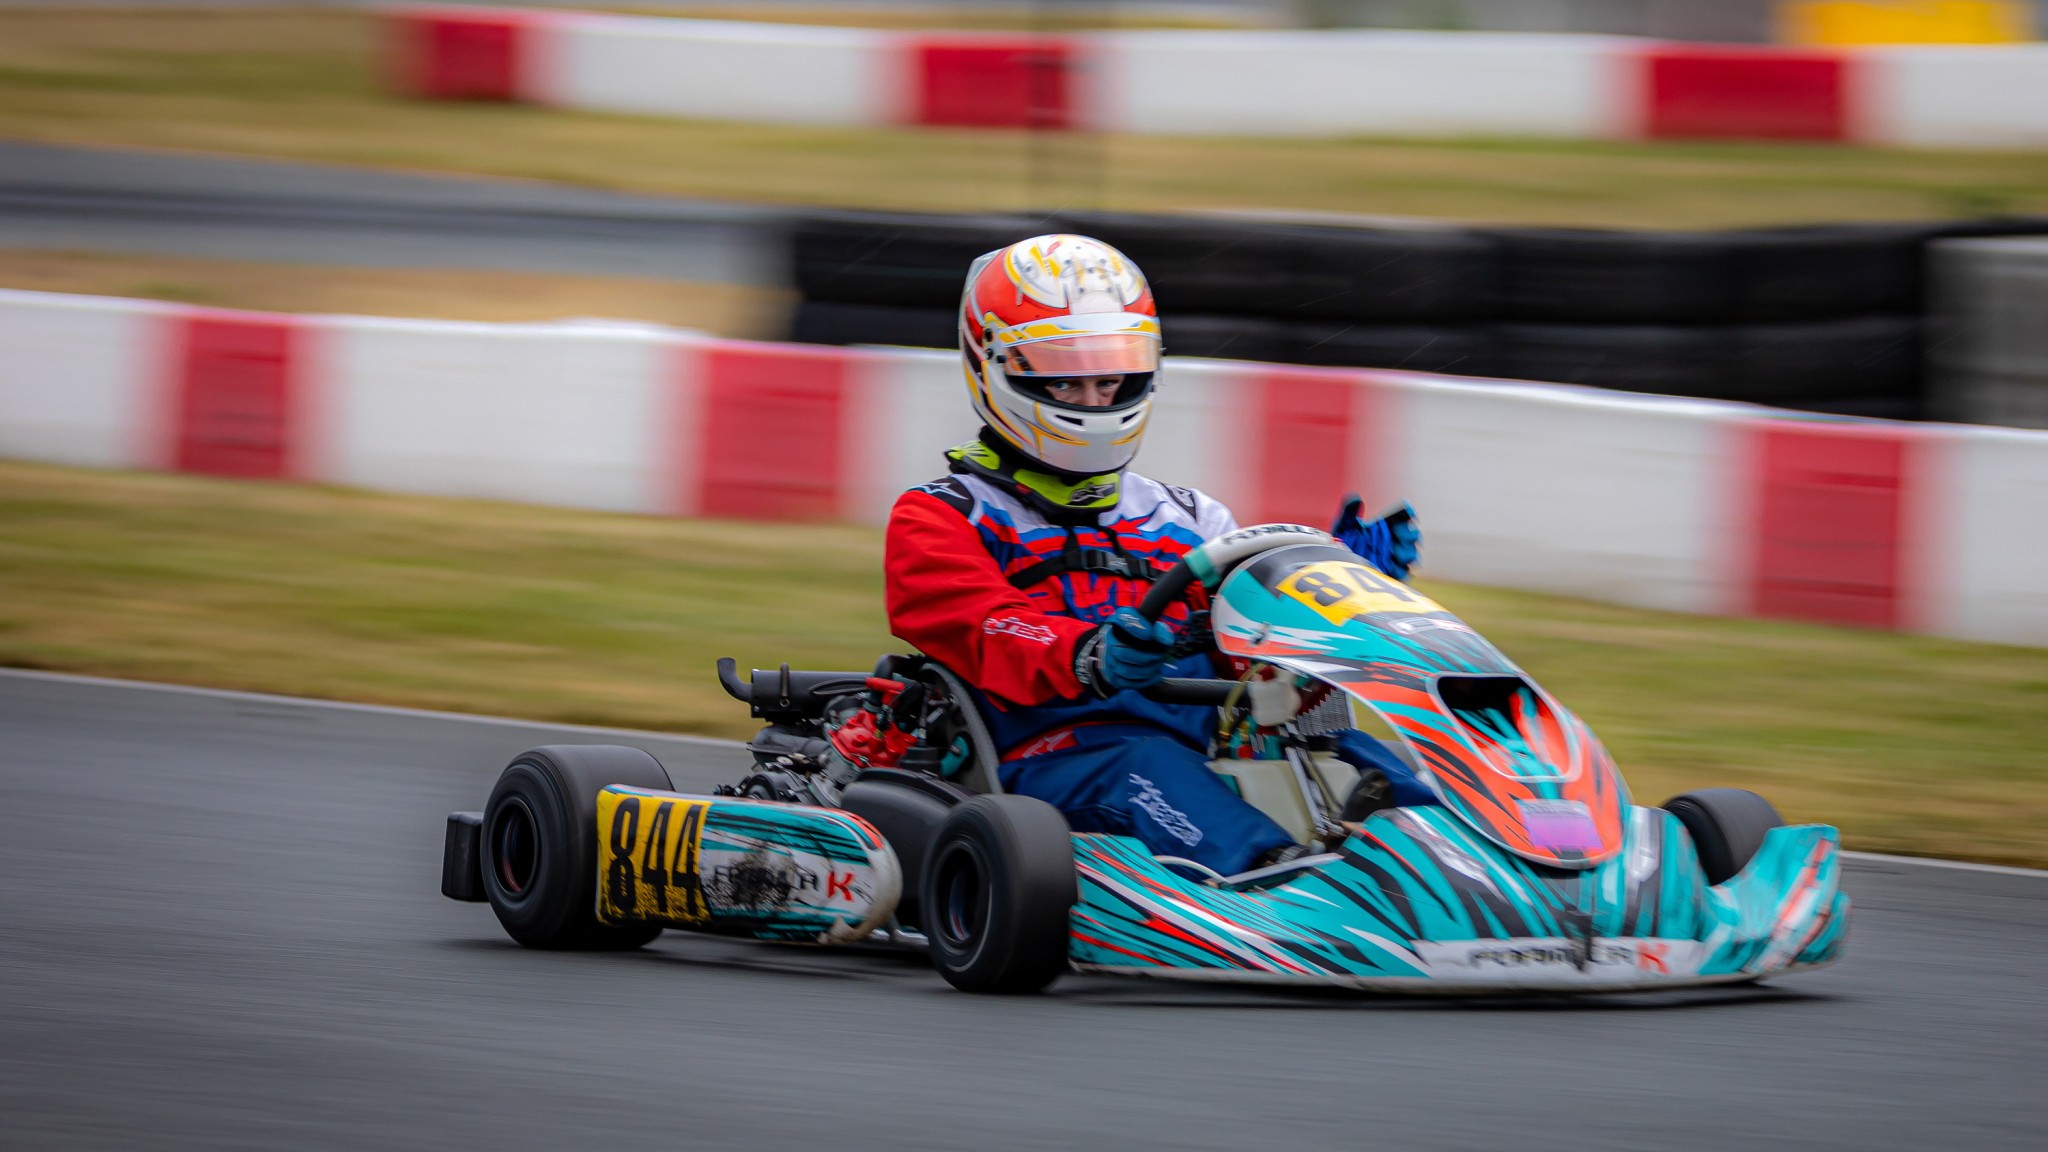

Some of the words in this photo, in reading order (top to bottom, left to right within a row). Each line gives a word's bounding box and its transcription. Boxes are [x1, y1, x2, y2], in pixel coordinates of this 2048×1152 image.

[1295, 566, 1425, 607] 84
[609, 797, 700, 916] 844
[826, 870, 854, 902] K
